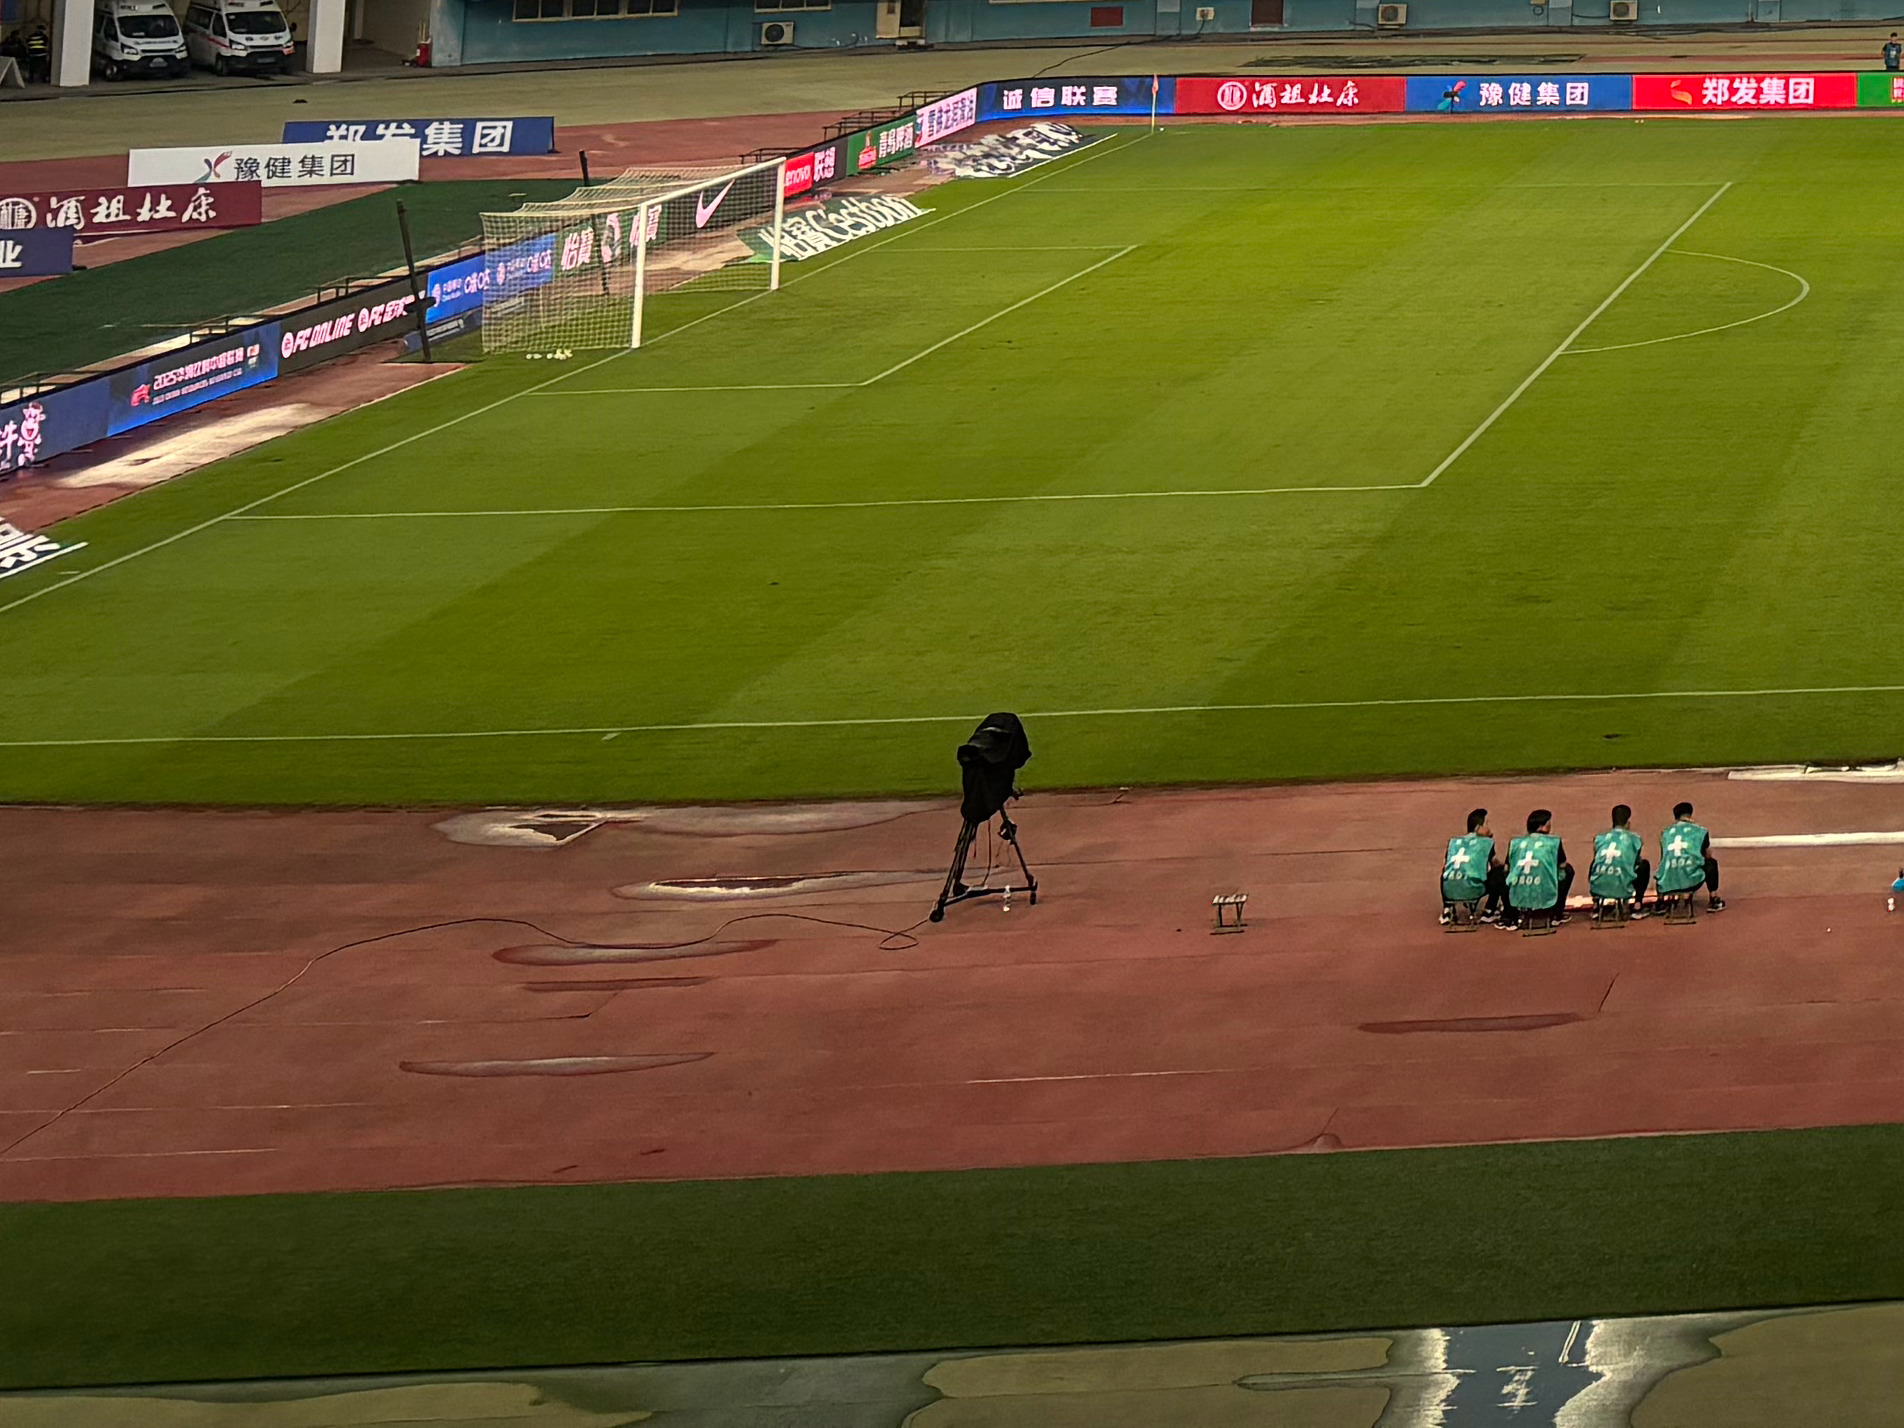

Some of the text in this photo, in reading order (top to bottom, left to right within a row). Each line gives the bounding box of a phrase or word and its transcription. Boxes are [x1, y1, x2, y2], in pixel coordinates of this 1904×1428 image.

[1003, 86, 1118, 110] 诚信联赛
[1252, 82, 1360, 108] 酒祖杜康
[1478, 81, 1589, 106] 豫健集团
[1702, 77, 1815, 106] 郑发集团
[234, 153, 356, 180] 豫健集团
[46, 187, 217, 230] 酒祖杜康
[311, 314, 356, 347] ONLINE
